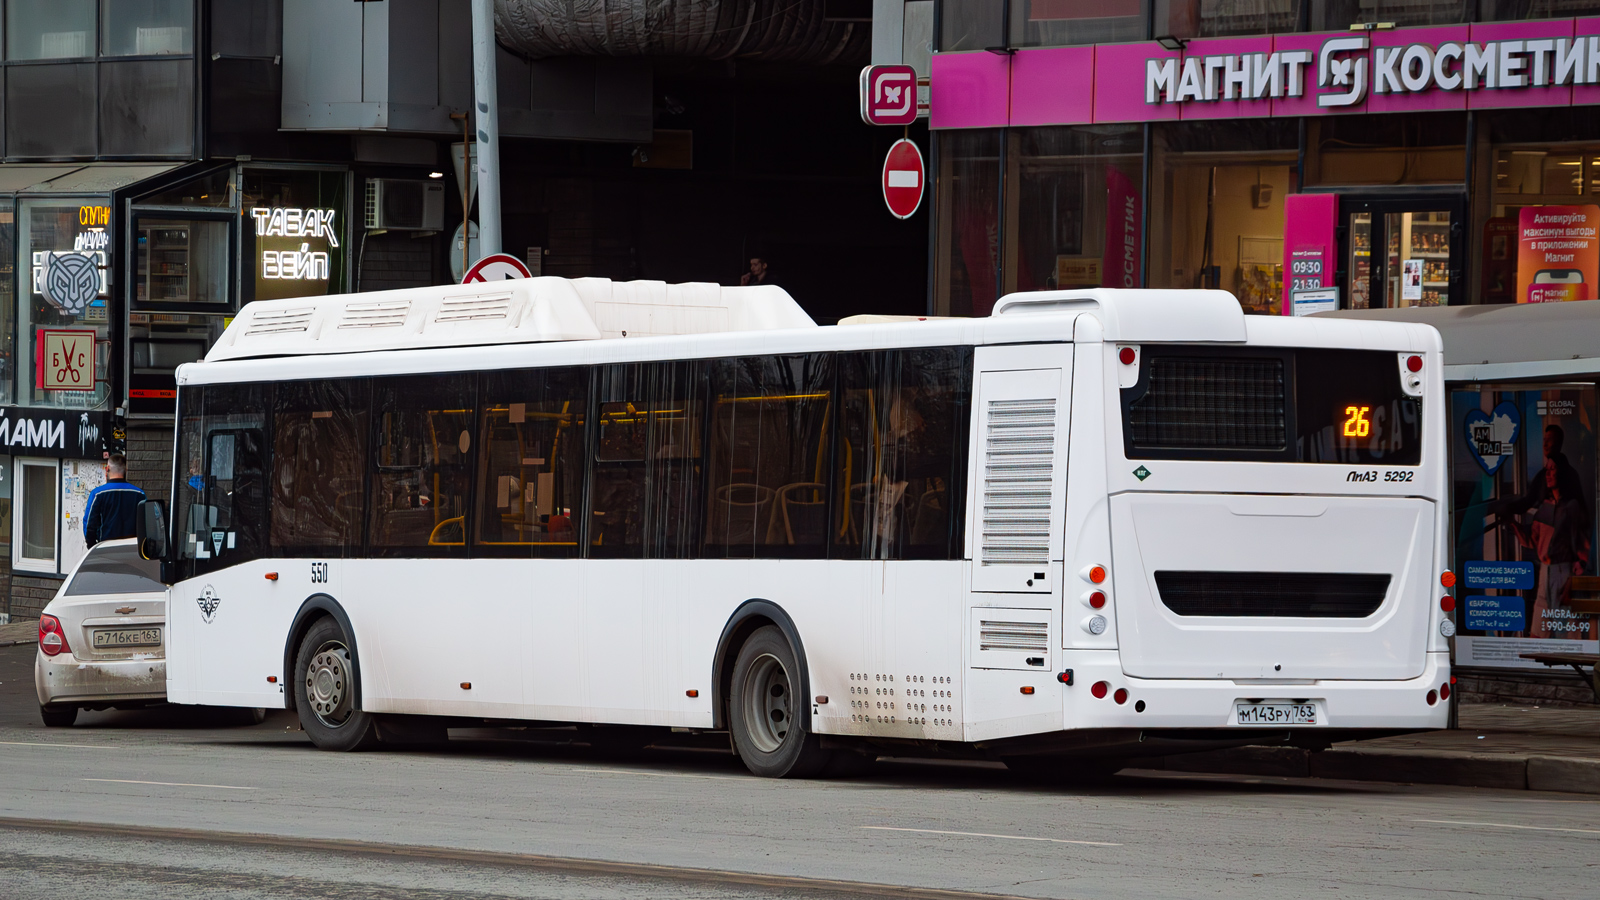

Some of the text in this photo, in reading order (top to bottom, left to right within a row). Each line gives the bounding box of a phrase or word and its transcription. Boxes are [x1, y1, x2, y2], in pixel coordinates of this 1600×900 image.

[1146, 51, 1308, 103] МАГНИТ
[1534, 213, 1587, 225] Активируйте
[252, 207, 339, 247] ТАБАК
[1524, 227, 1596, 238] максимум выгоды
[1537, 241, 1589, 251] приложении
[263, 243, 328, 279] ВЕЙП
[1545, 253, 1574, 262] Магнит
[1293, 262, 1321, 273] 09:30
[1293, 279, 1320, 290] 21:30
[53, 353, 85, 367] Б С
[1344, 406, 1369, 436] 26
[1476, 429, 1489, 440] АМ
[1478, 443, 1501, 454] ГРАД
[1346, 471, 1414, 482] ЛиАЗ 5292
[311, 562, 328, 583] 550
[1546, 621, 1590, 632] 990-66-99
[97, 630, 158, 644] Р716КЕ 163
[1241, 705, 1313, 721] М143РУ 763
